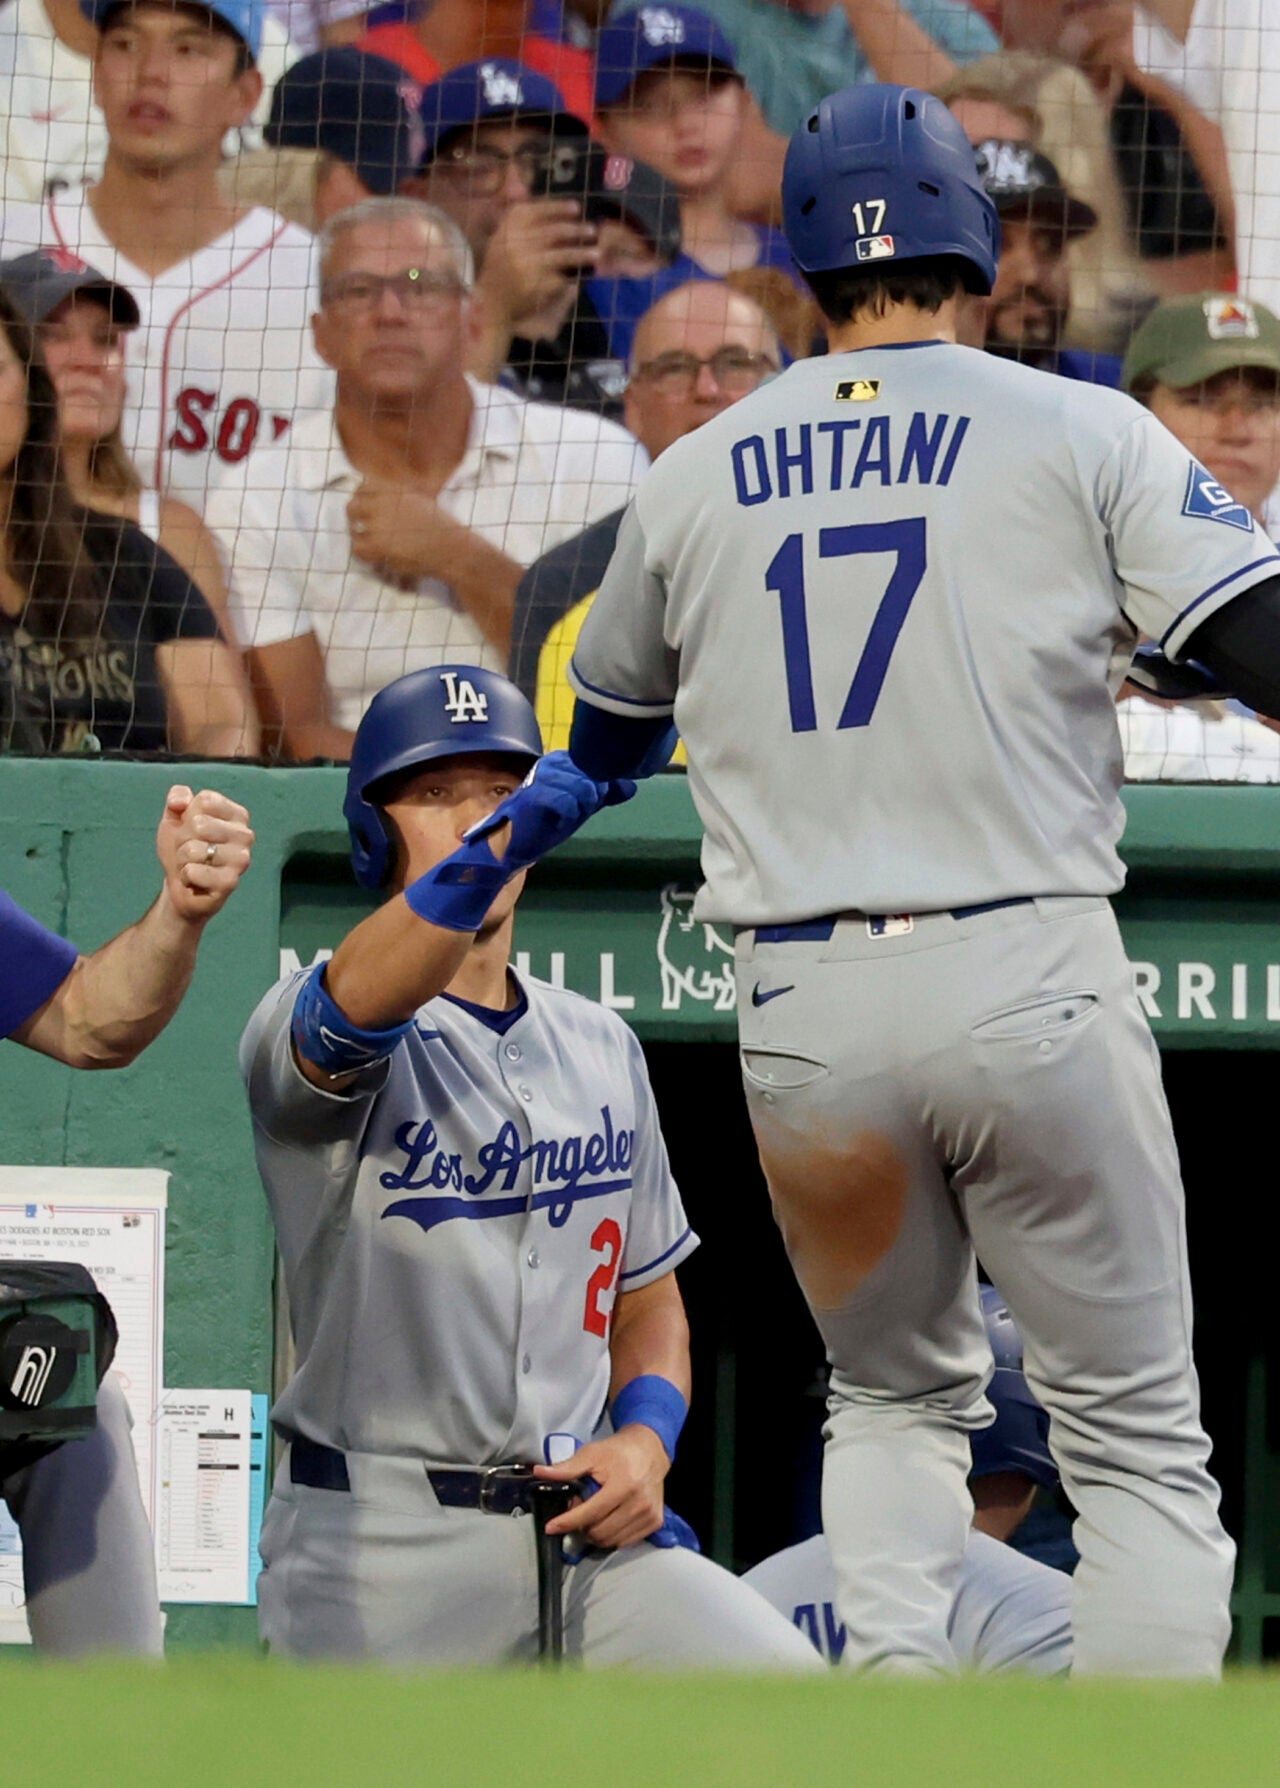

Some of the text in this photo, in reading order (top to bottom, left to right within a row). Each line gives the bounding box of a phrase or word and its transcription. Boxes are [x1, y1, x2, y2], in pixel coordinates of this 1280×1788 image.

[852, 199, 887, 235] 17
[169, 386, 290, 464] SO
[731, 411, 971, 507] OHTANI
[765, 516, 928, 733] 17
[440, 672, 488, 723] LA
[380, 1105, 634, 1228] Los Angele
[224, 1407, 234, 1421] H
